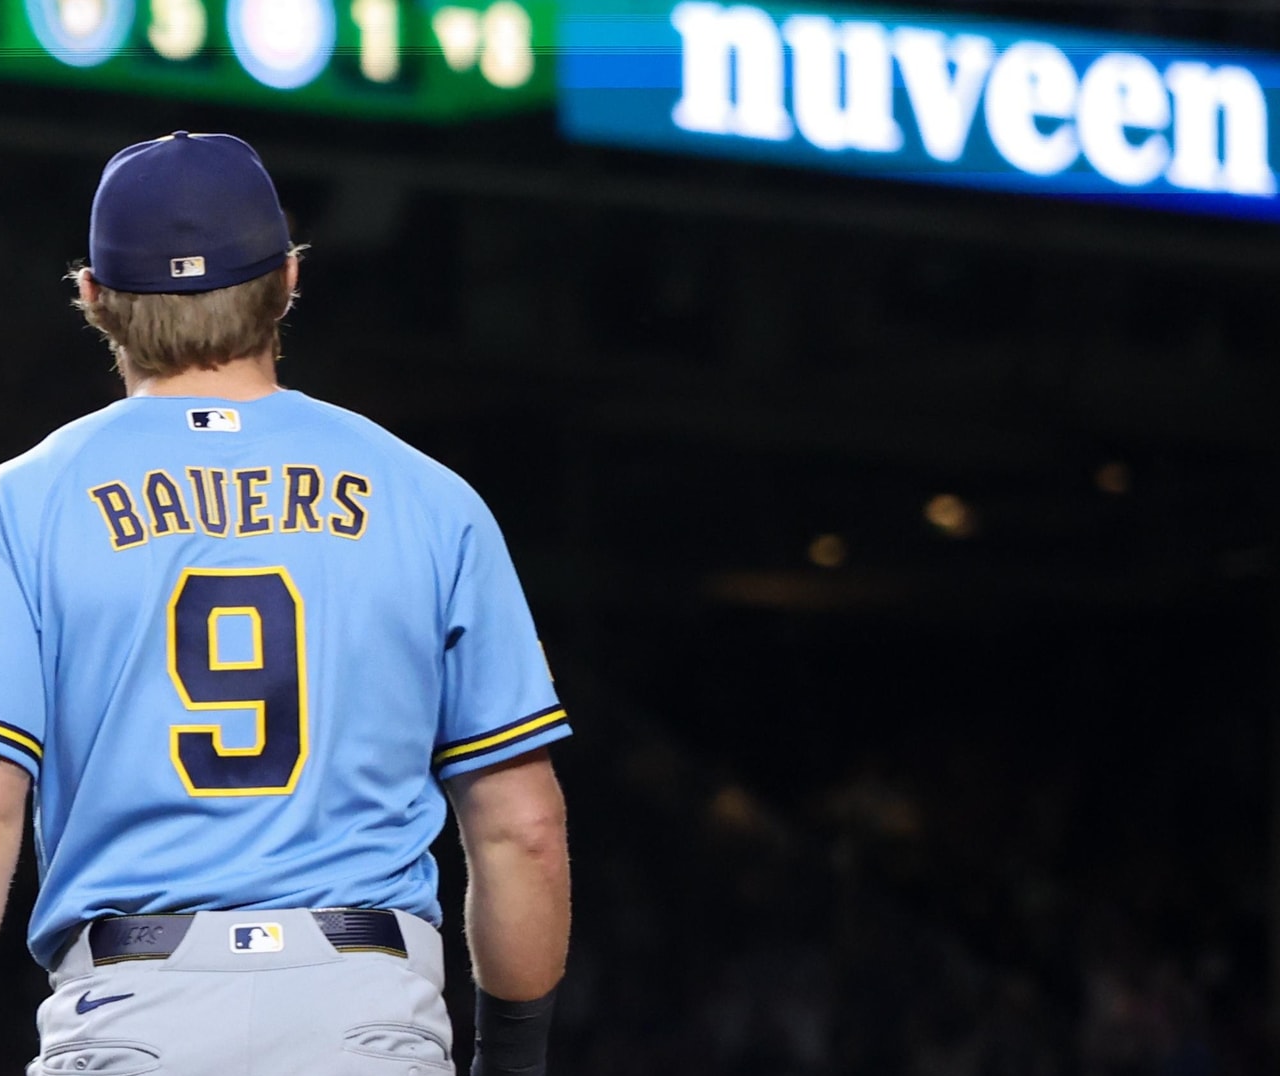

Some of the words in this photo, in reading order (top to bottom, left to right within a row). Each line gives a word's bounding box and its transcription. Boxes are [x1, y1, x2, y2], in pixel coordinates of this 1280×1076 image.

[670, 0, 1278, 198] nuveen
[88, 464, 372, 551] BAUERS
[166, 565, 310, 797] 9
